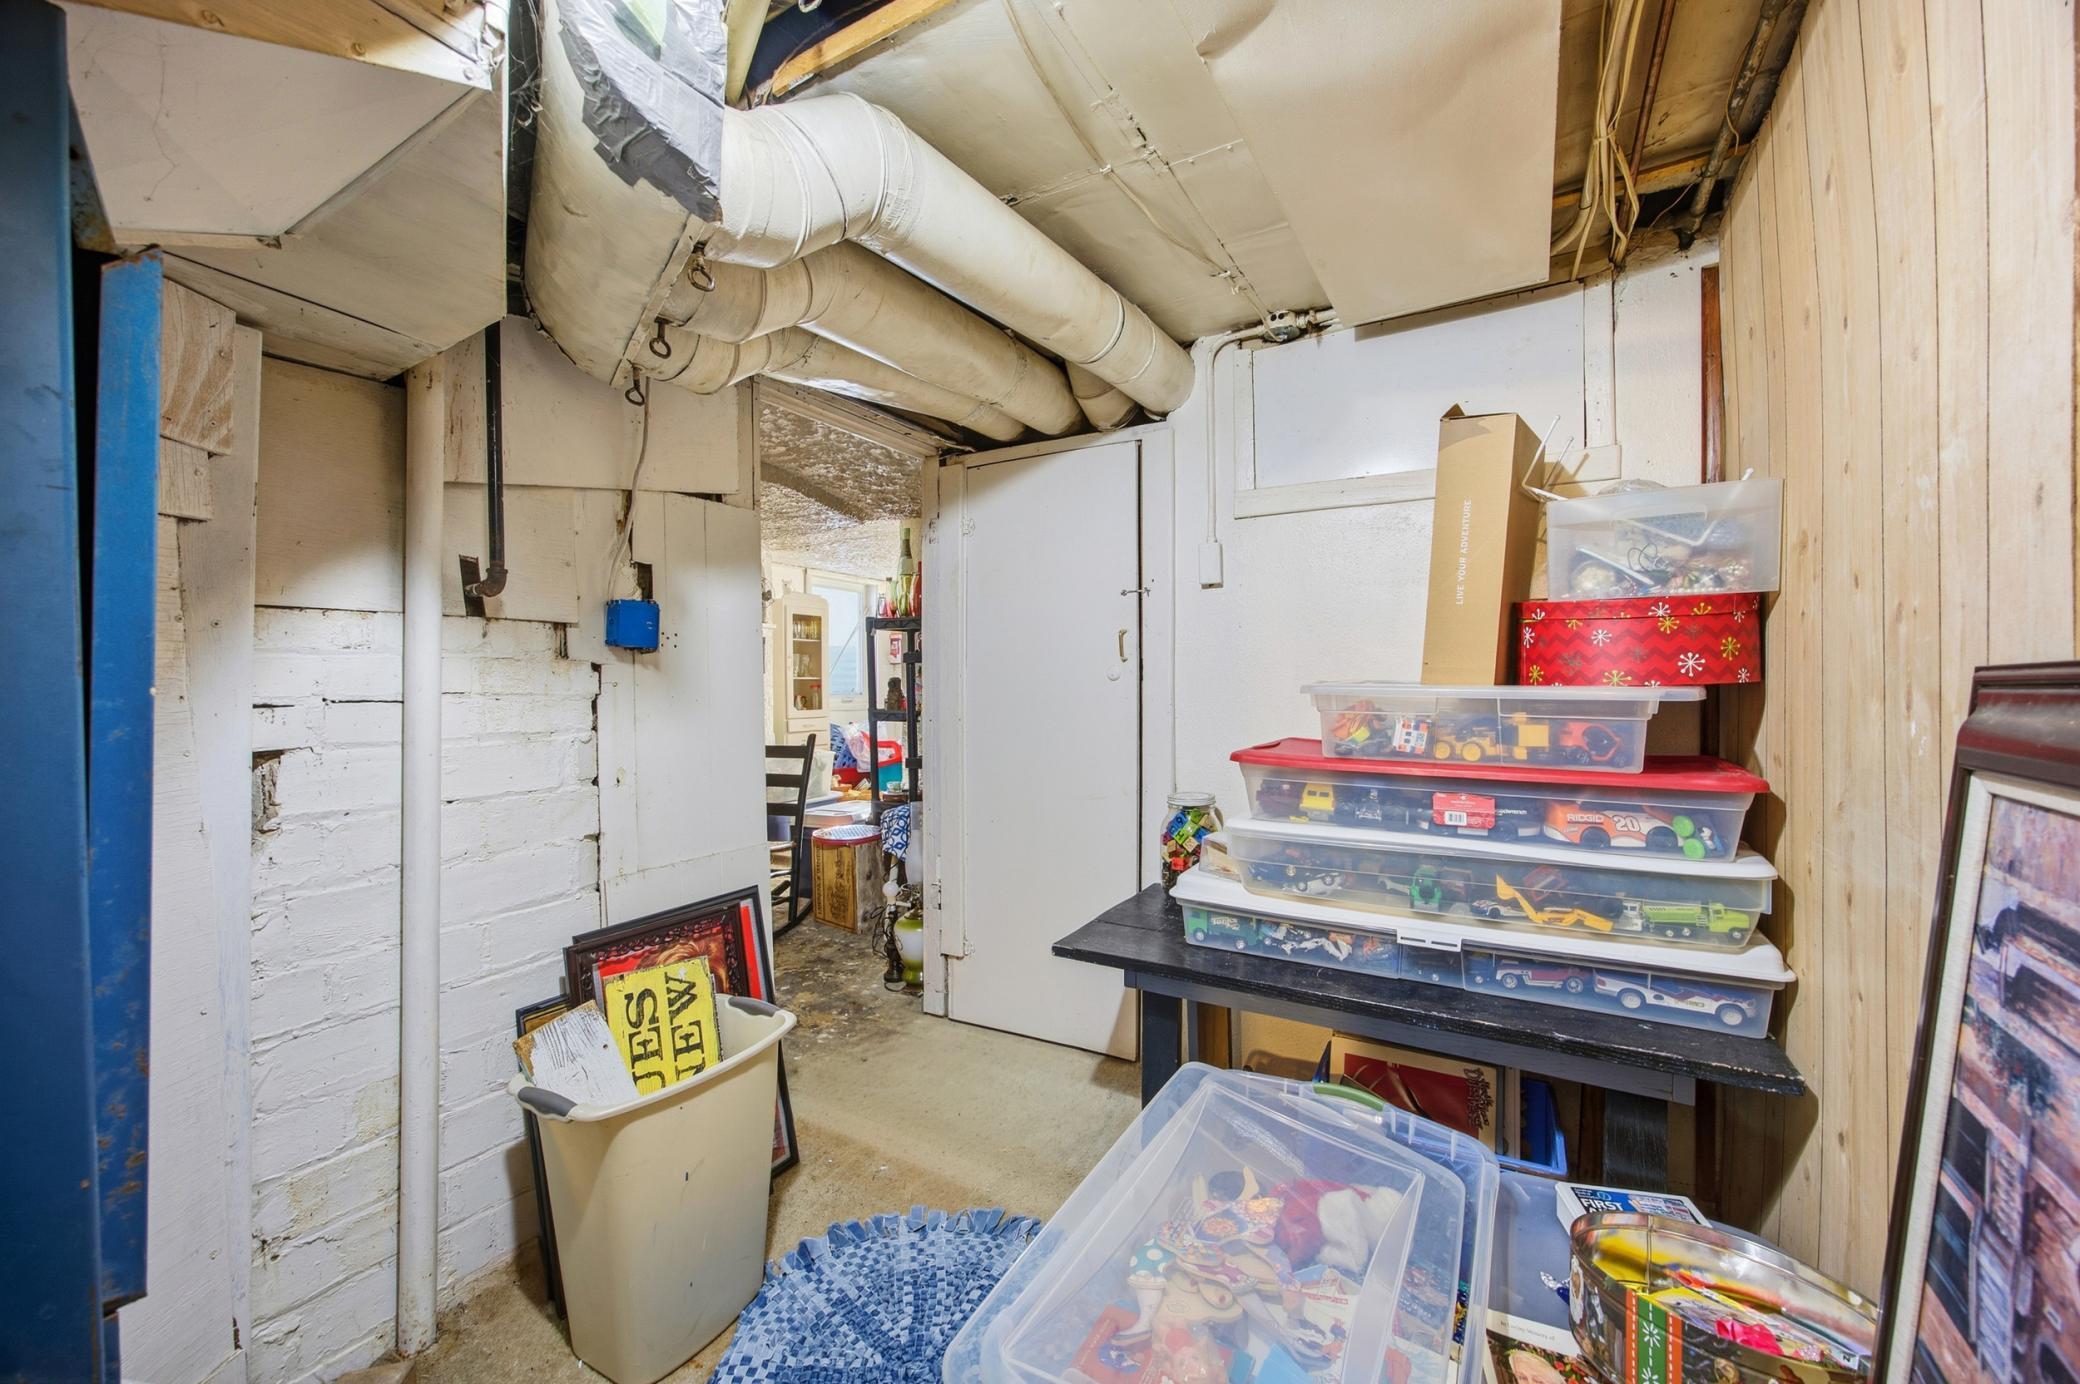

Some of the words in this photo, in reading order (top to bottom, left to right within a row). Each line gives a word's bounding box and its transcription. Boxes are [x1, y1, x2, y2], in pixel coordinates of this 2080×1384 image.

[1460, 499, 1472, 554] ADVENTURE
[1458, 557, 1467, 582] YOUR
[1455, 585, 1464, 605] LIVE
[1612, 814, 1641, 832] 20
[1580, 1198, 1623, 1212] FIRST
